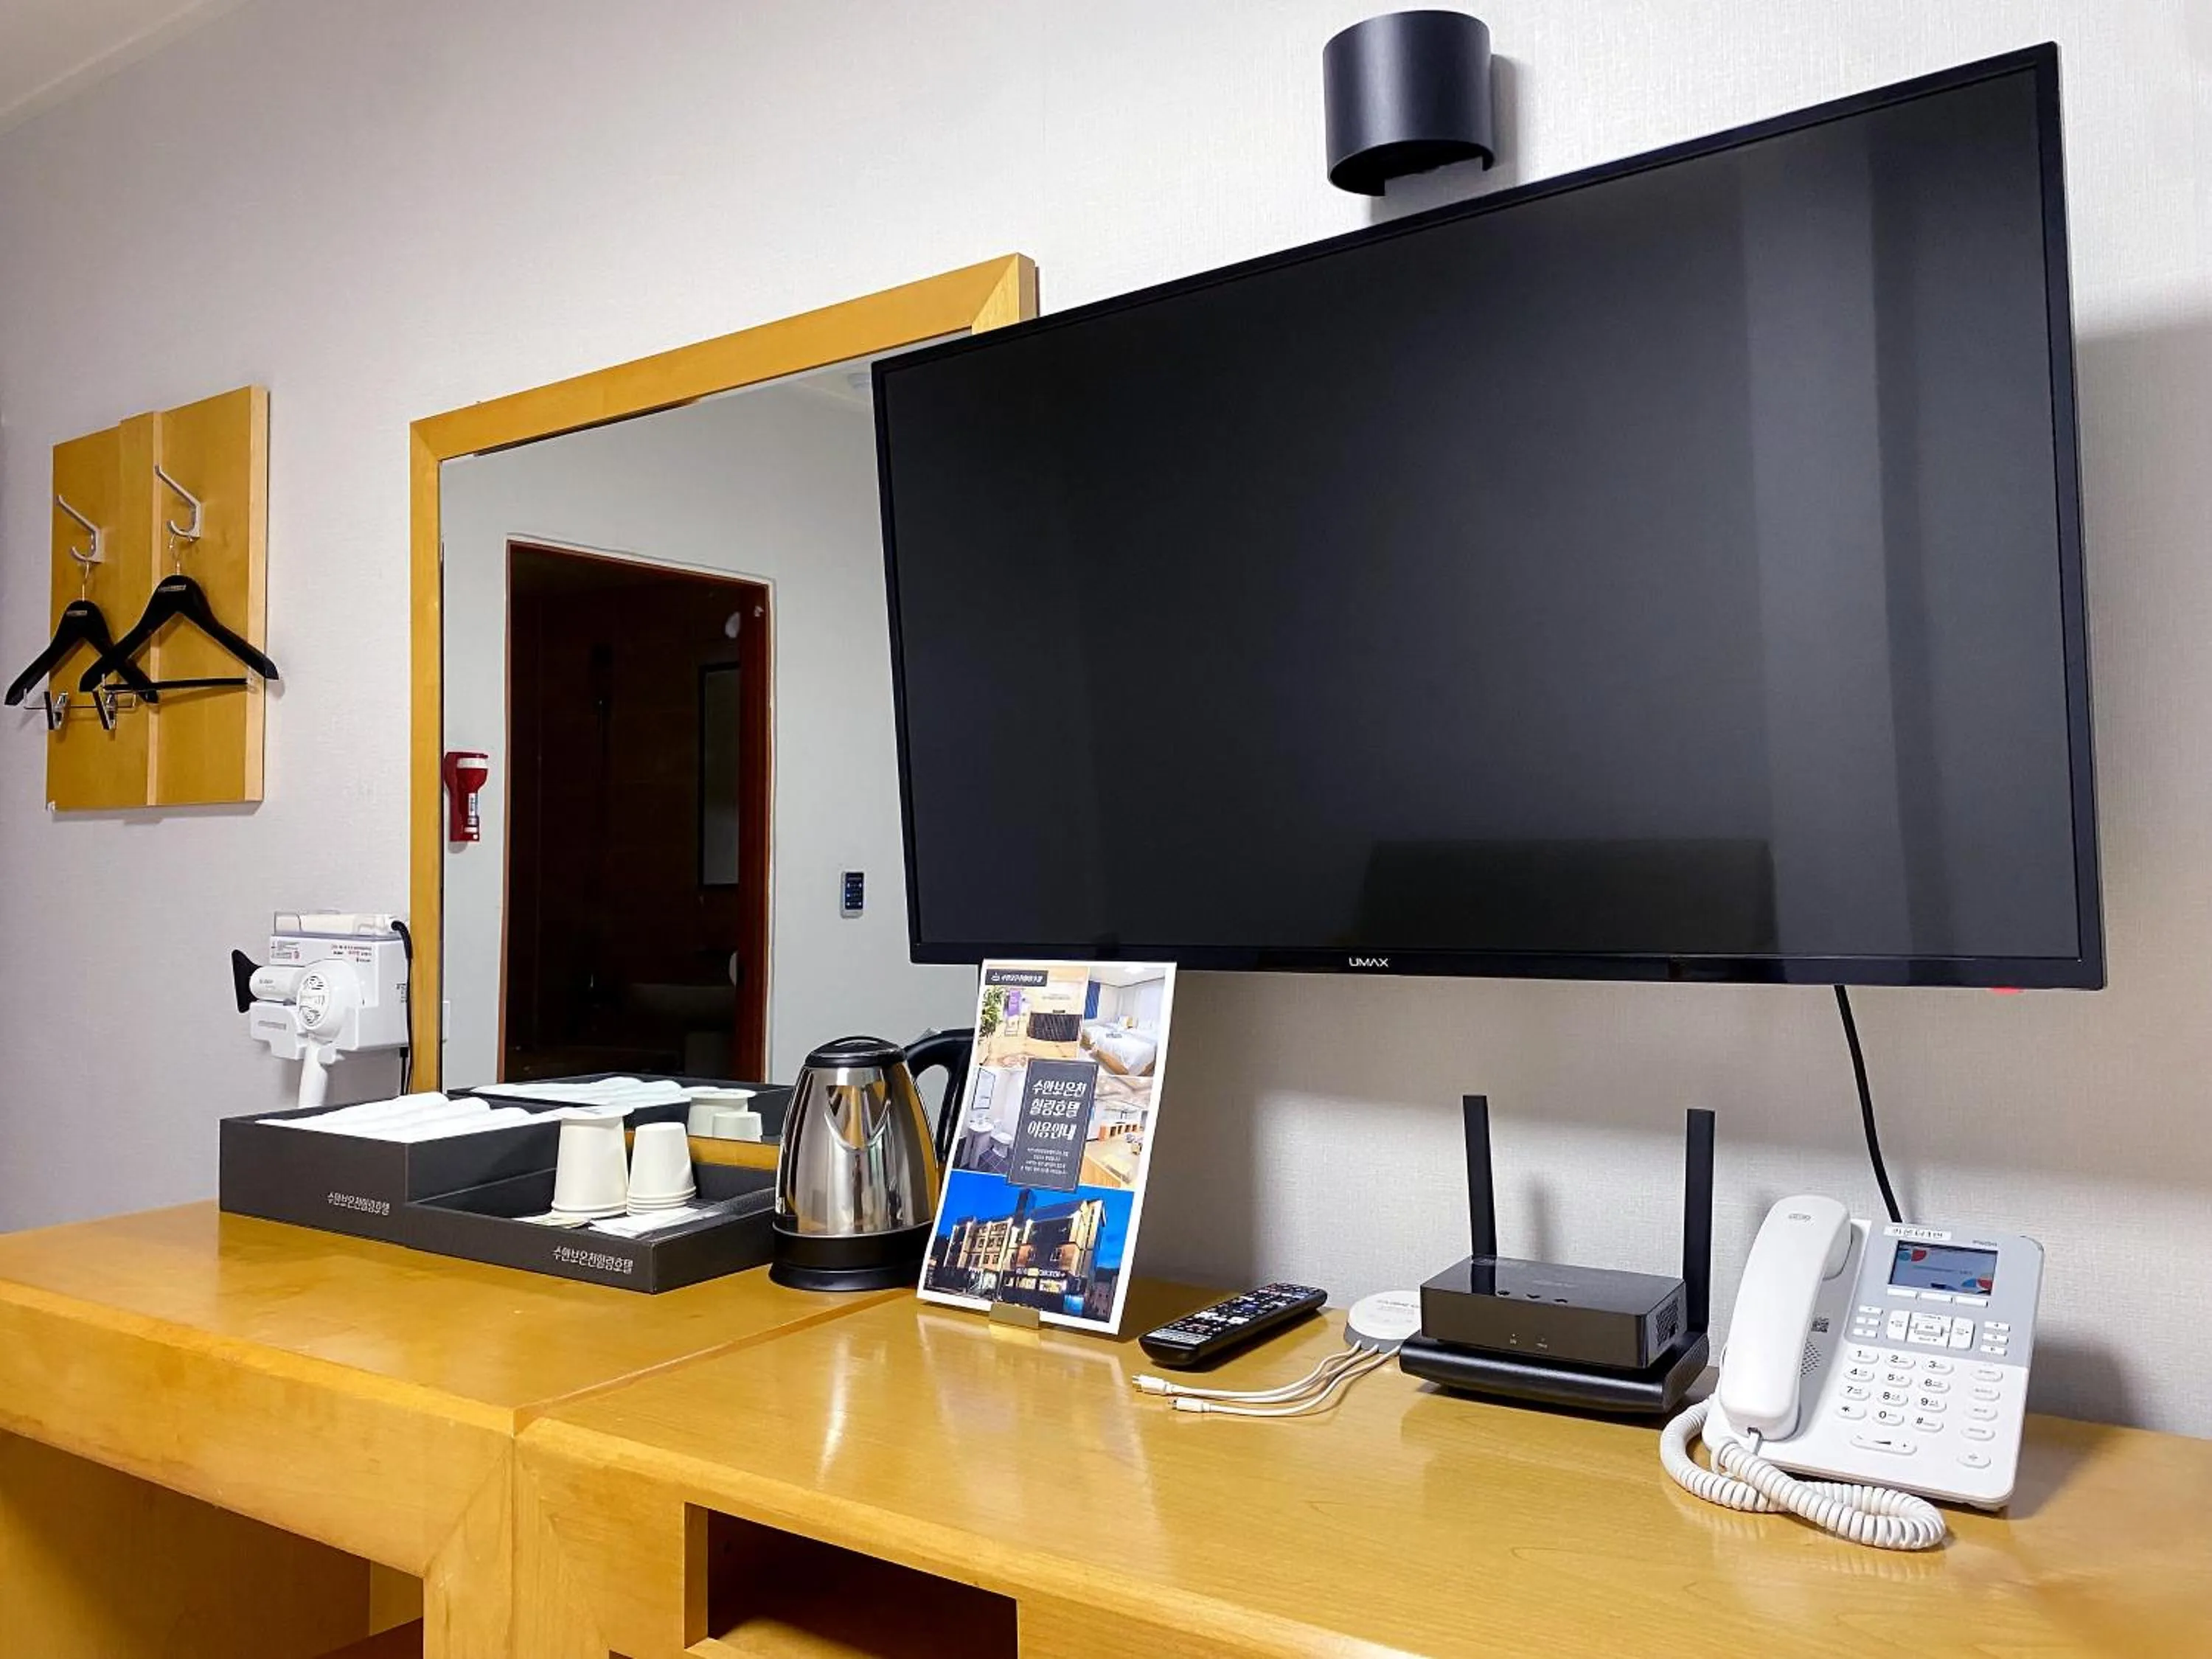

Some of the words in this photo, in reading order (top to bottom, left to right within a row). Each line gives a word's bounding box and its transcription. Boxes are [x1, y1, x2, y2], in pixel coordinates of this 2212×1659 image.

[1348, 956, 1390, 968] UMAX
[1032, 1079, 1088, 1098] 수안보온천
[1029, 1098, 1082, 1119] 힐링호텔
[1027, 1120, 1077, 1141] 이용안내
[552, 1245, 634, 1275] 수안보온천힐링호텔
[1891, 1354, 1899, 1363] 2
[1928, 1360, 1937, 1368] 3
[1924, 1378, 1933, 1387] 6
[1846, 1385, 1854, 1394] 7
[1882, 1391, 1891, 1400] 8
[1921, 1397, 1929, 1406] 9
[1879, 1411, 1887, 1419] 0
